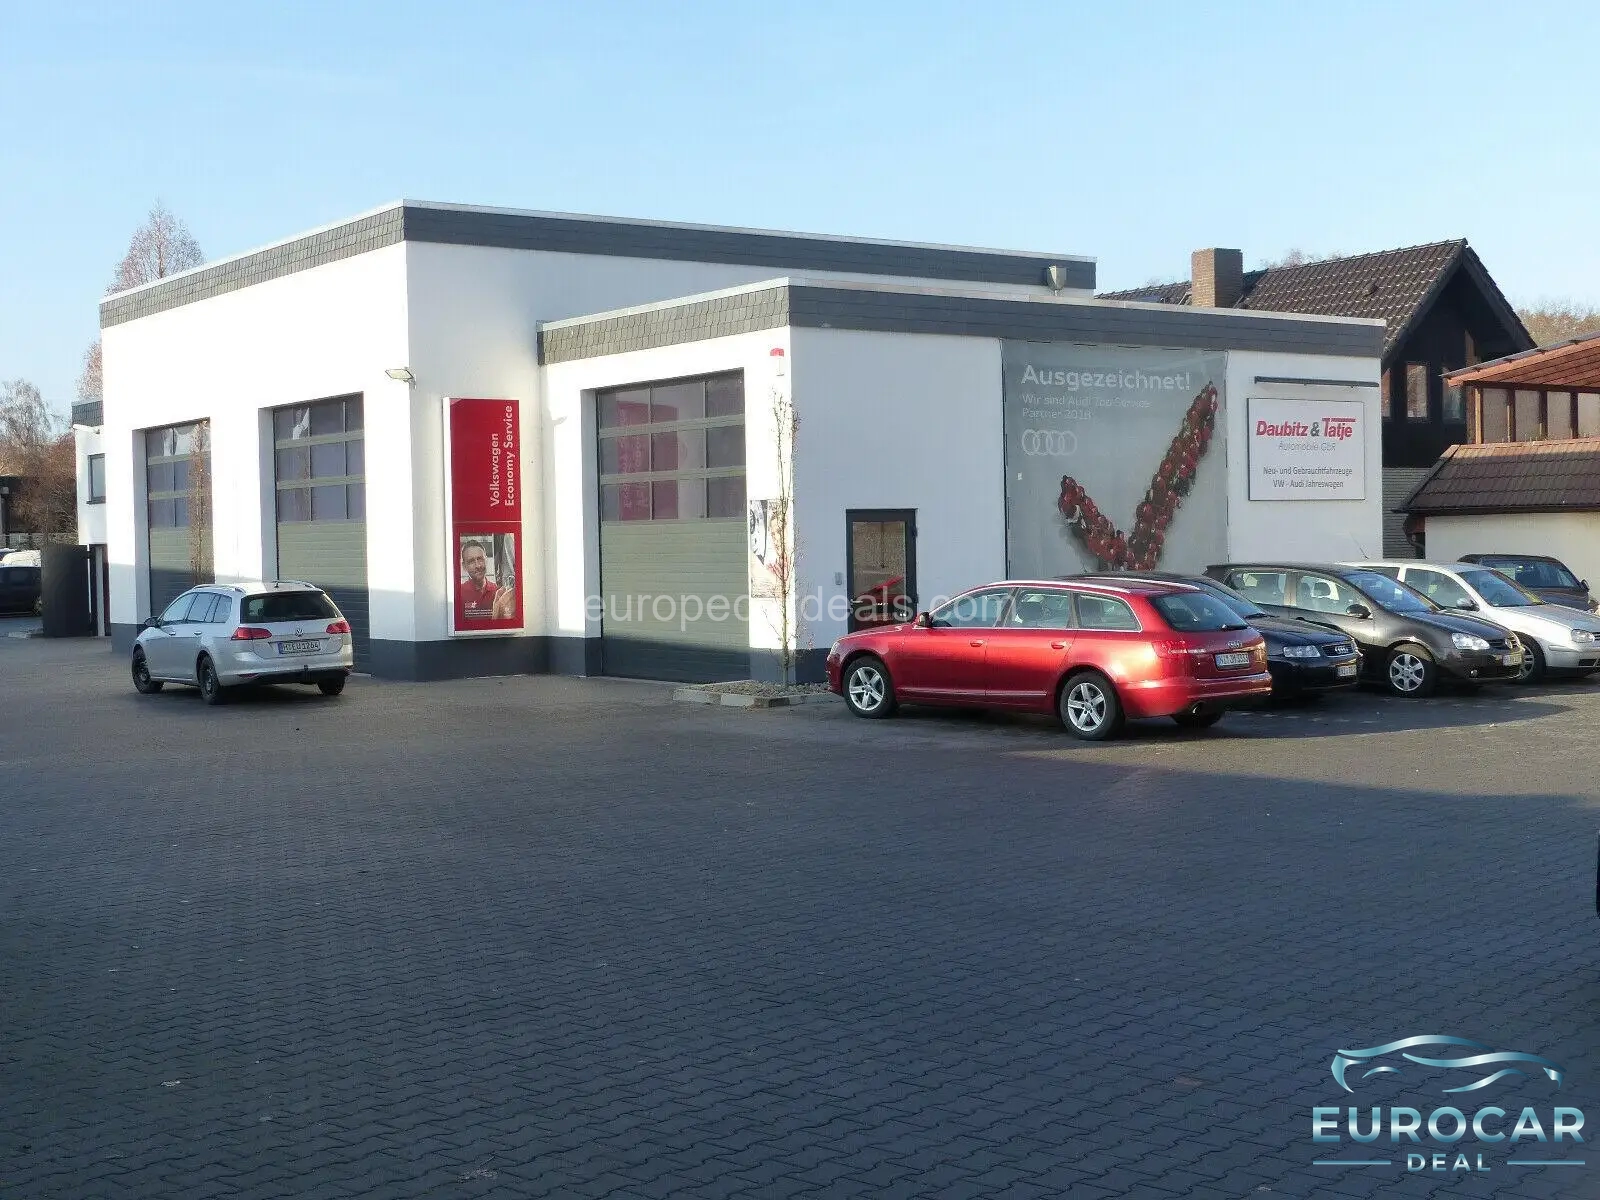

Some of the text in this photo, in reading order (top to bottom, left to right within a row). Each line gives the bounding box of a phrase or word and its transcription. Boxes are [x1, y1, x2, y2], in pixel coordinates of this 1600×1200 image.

[1021, 364, 1191, 391] Ausgezeichnet!
[1044, 395, 1065, 406] sind
[1256, 418, 1353, 440] Daubitz & Tatje
[503, 405, 515, 506] Economy Service
[490, 433, 500, 507] Volkswagen
[1263, 467, 1353, 476] Neu- und Gebrauchtfahrzeuge
[1305, 480, 1344, 489] Jahreswagen
